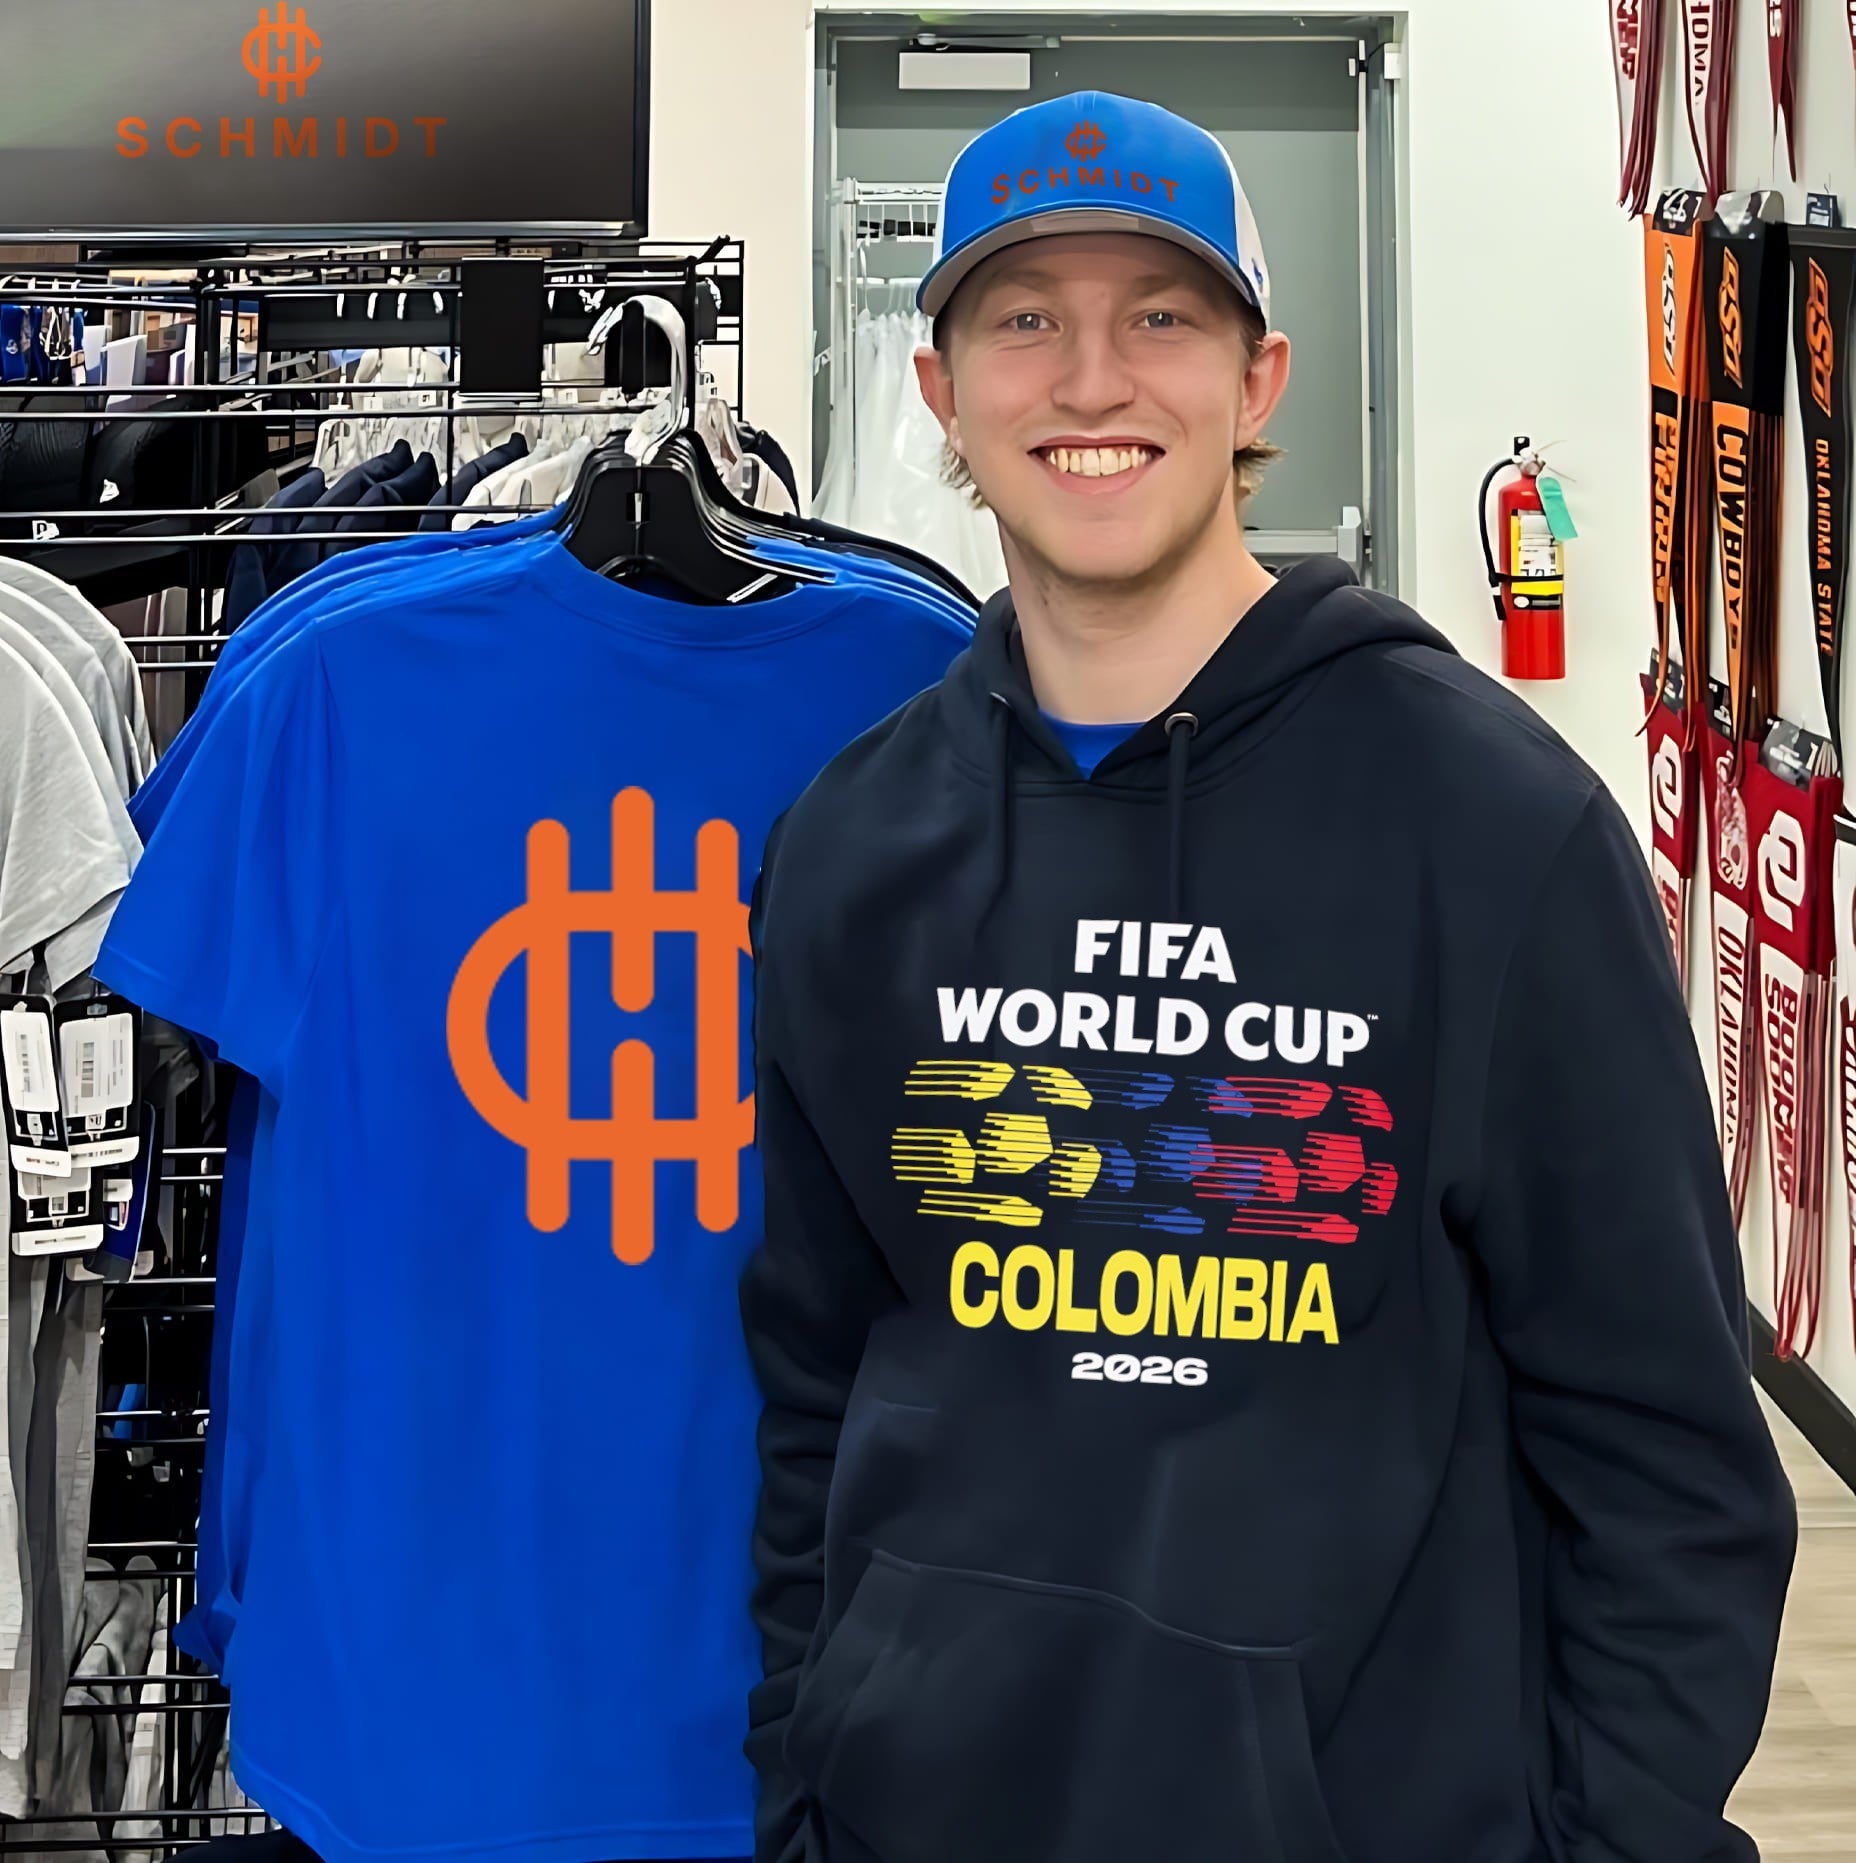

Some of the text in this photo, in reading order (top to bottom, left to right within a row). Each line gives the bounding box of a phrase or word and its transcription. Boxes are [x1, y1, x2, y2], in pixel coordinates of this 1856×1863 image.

[116, 116, 446, 159] SCHMIDT
[992, 167, 1179, 204] SCHMIDT
[1815, 439, 1832, 570] OKLAHOMA
[1074, 919, 1237, 984] FIFA
[936, 987, 1210, 1056] WORLD
[949, 1240, 1340, 1344] COLOMBIA
[1071, 1351, 1209, 1386] 2026
